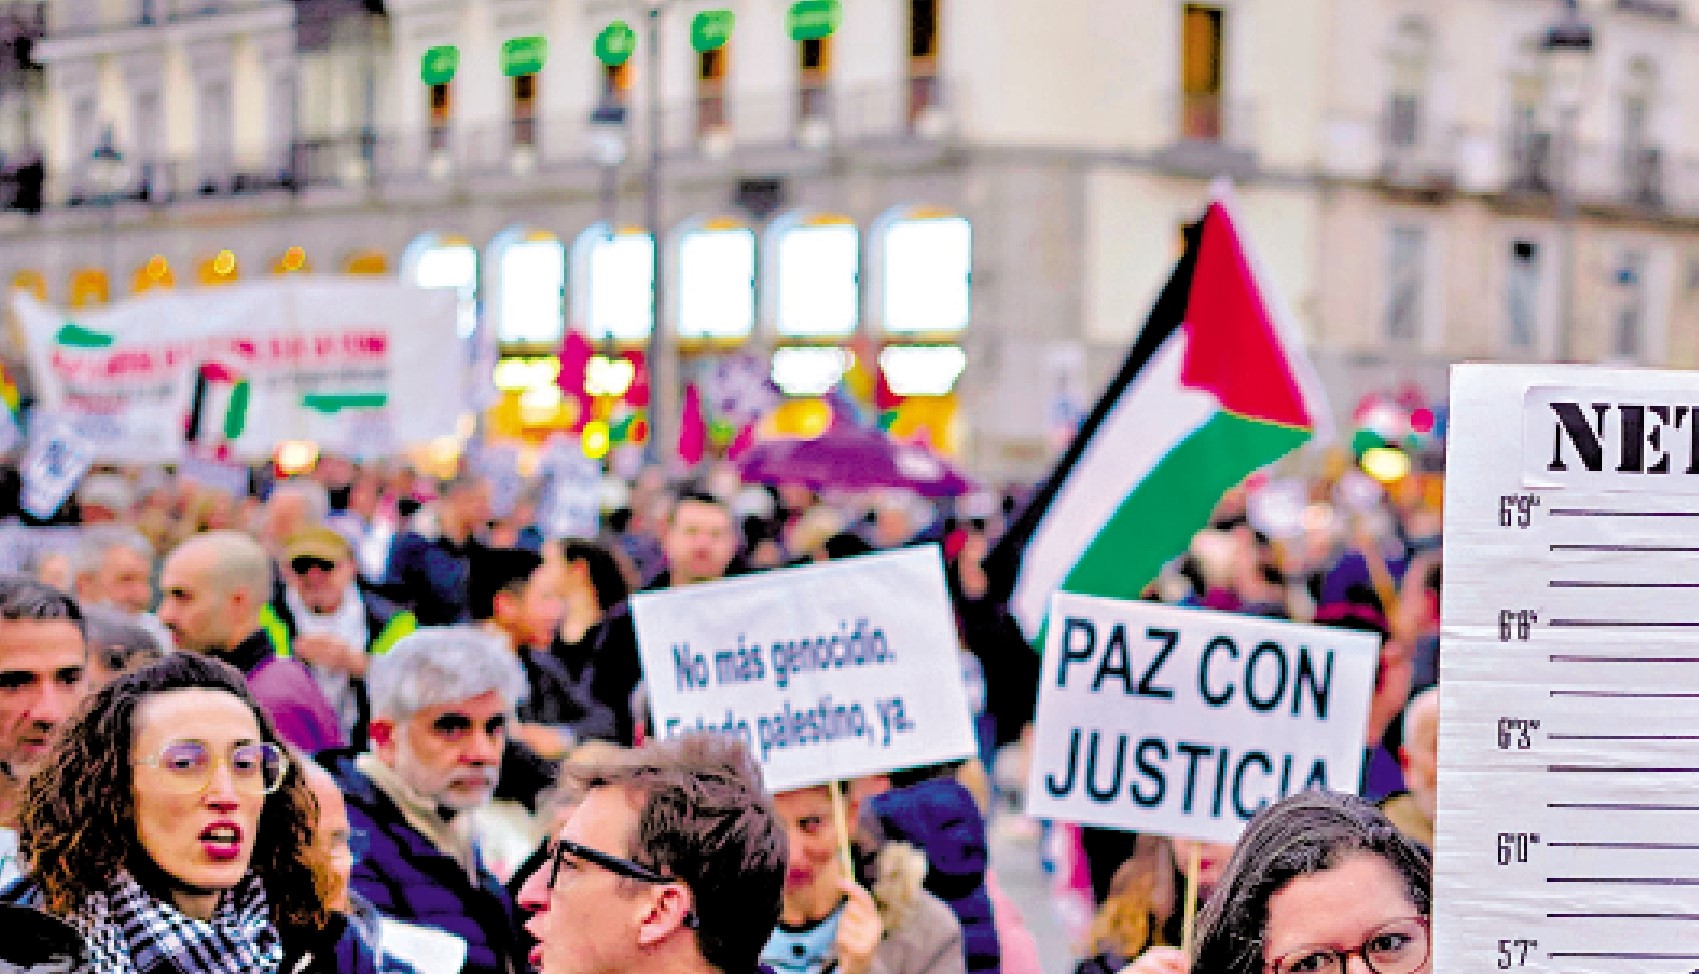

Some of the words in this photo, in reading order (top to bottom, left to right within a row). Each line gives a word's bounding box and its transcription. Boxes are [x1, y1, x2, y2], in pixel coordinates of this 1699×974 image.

[672, 641, 709, 693] No
[716, 631, 765, 685] más
[771, 616, 897, 690] genocidio.
[1056, 616, 1182, 700] PAZ
[1199, 634, 1337, 721] CON
[757, 693, 875, 763] palestino,
[874, 695, 916, 749] ya.
